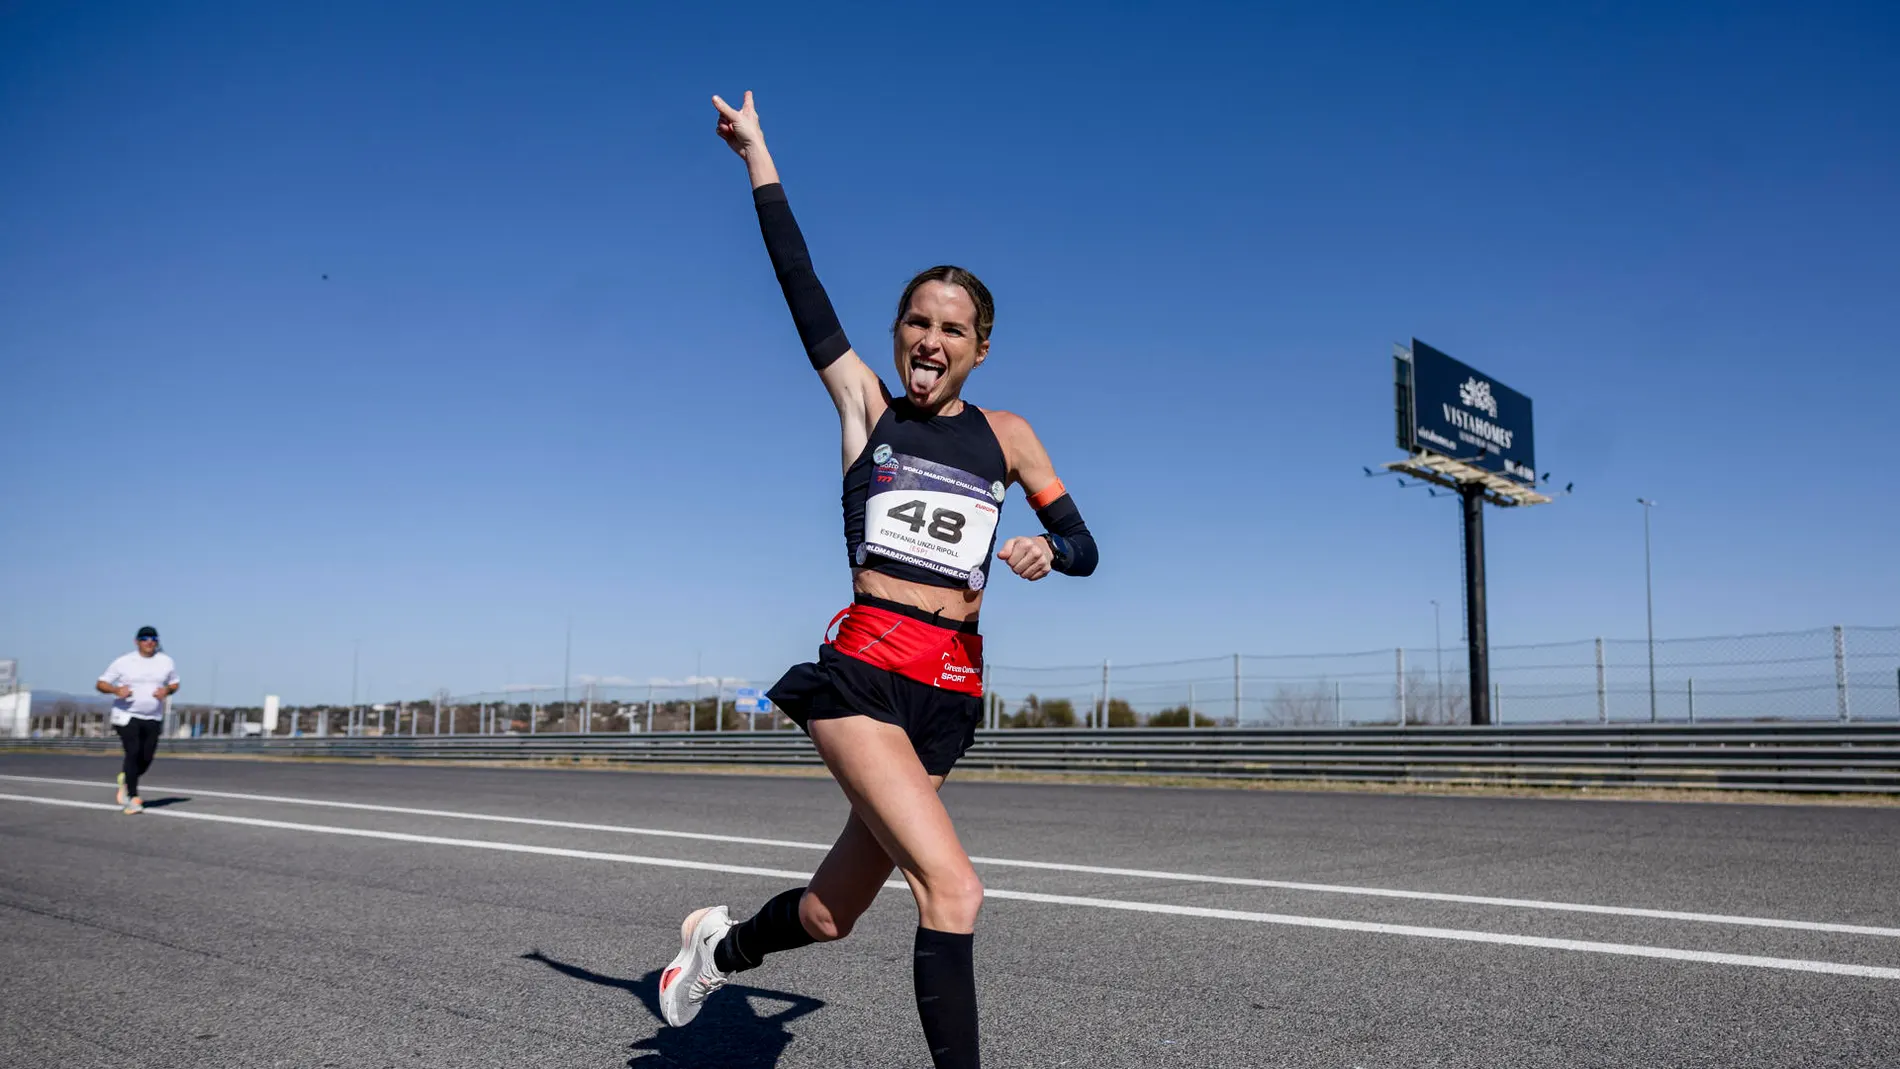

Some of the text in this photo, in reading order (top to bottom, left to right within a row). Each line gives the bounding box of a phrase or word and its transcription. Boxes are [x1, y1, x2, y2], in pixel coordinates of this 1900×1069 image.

[1442, 402, 1512, 449] VISTAHOMES
[877, 475, 893, 483] 777
[902, 465, 923, 475] WORLD
[923, 471, 956, 485] MARATHON
[955, 480, 987, 495] CHALLENGE
[886, 499, 966, 544] 48
[975, 503, 996, 513] EUROPE
[880, 528, 959, 558] ESTEFANIA UNZU RIPOLL
[866, 545, 969, 579] RLDMARATHONCHALLENGE.CO
[941, 672, 966, 682] SPORT
